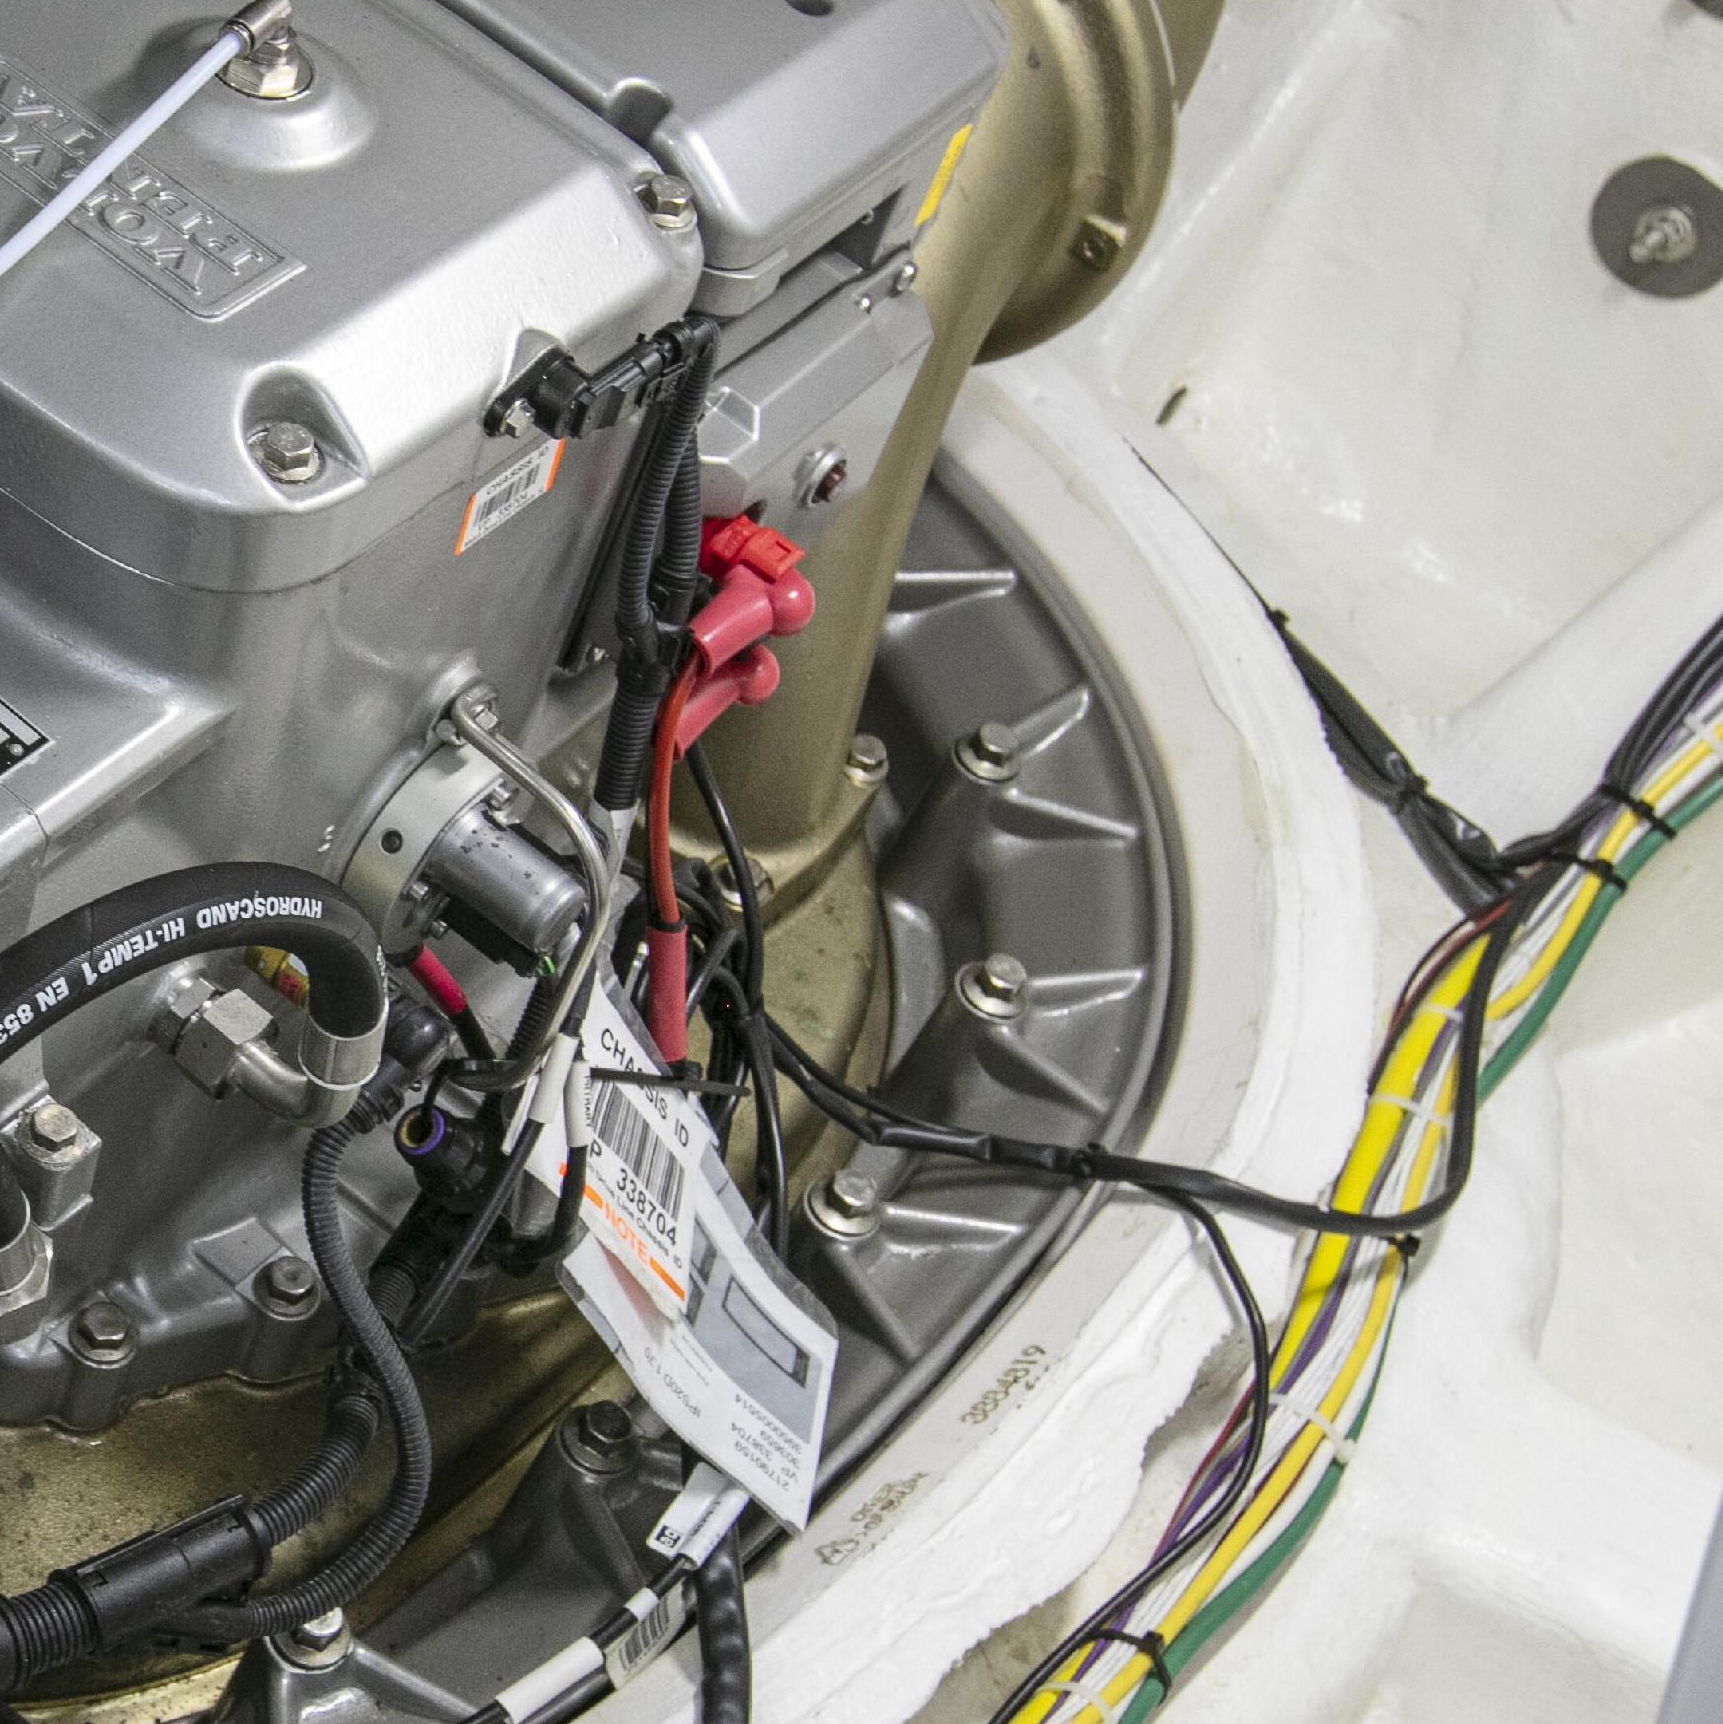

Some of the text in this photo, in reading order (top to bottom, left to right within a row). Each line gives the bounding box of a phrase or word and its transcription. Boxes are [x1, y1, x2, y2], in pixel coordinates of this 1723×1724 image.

[196, 896, 324, 929] HYDROSCAND
[35, 976, 70, 1012] EN
[674, 1117, 690, 1148] ID
[617, 1168, 677, 1246] 338704
[603, 1200, 648, 1260] NOTE
